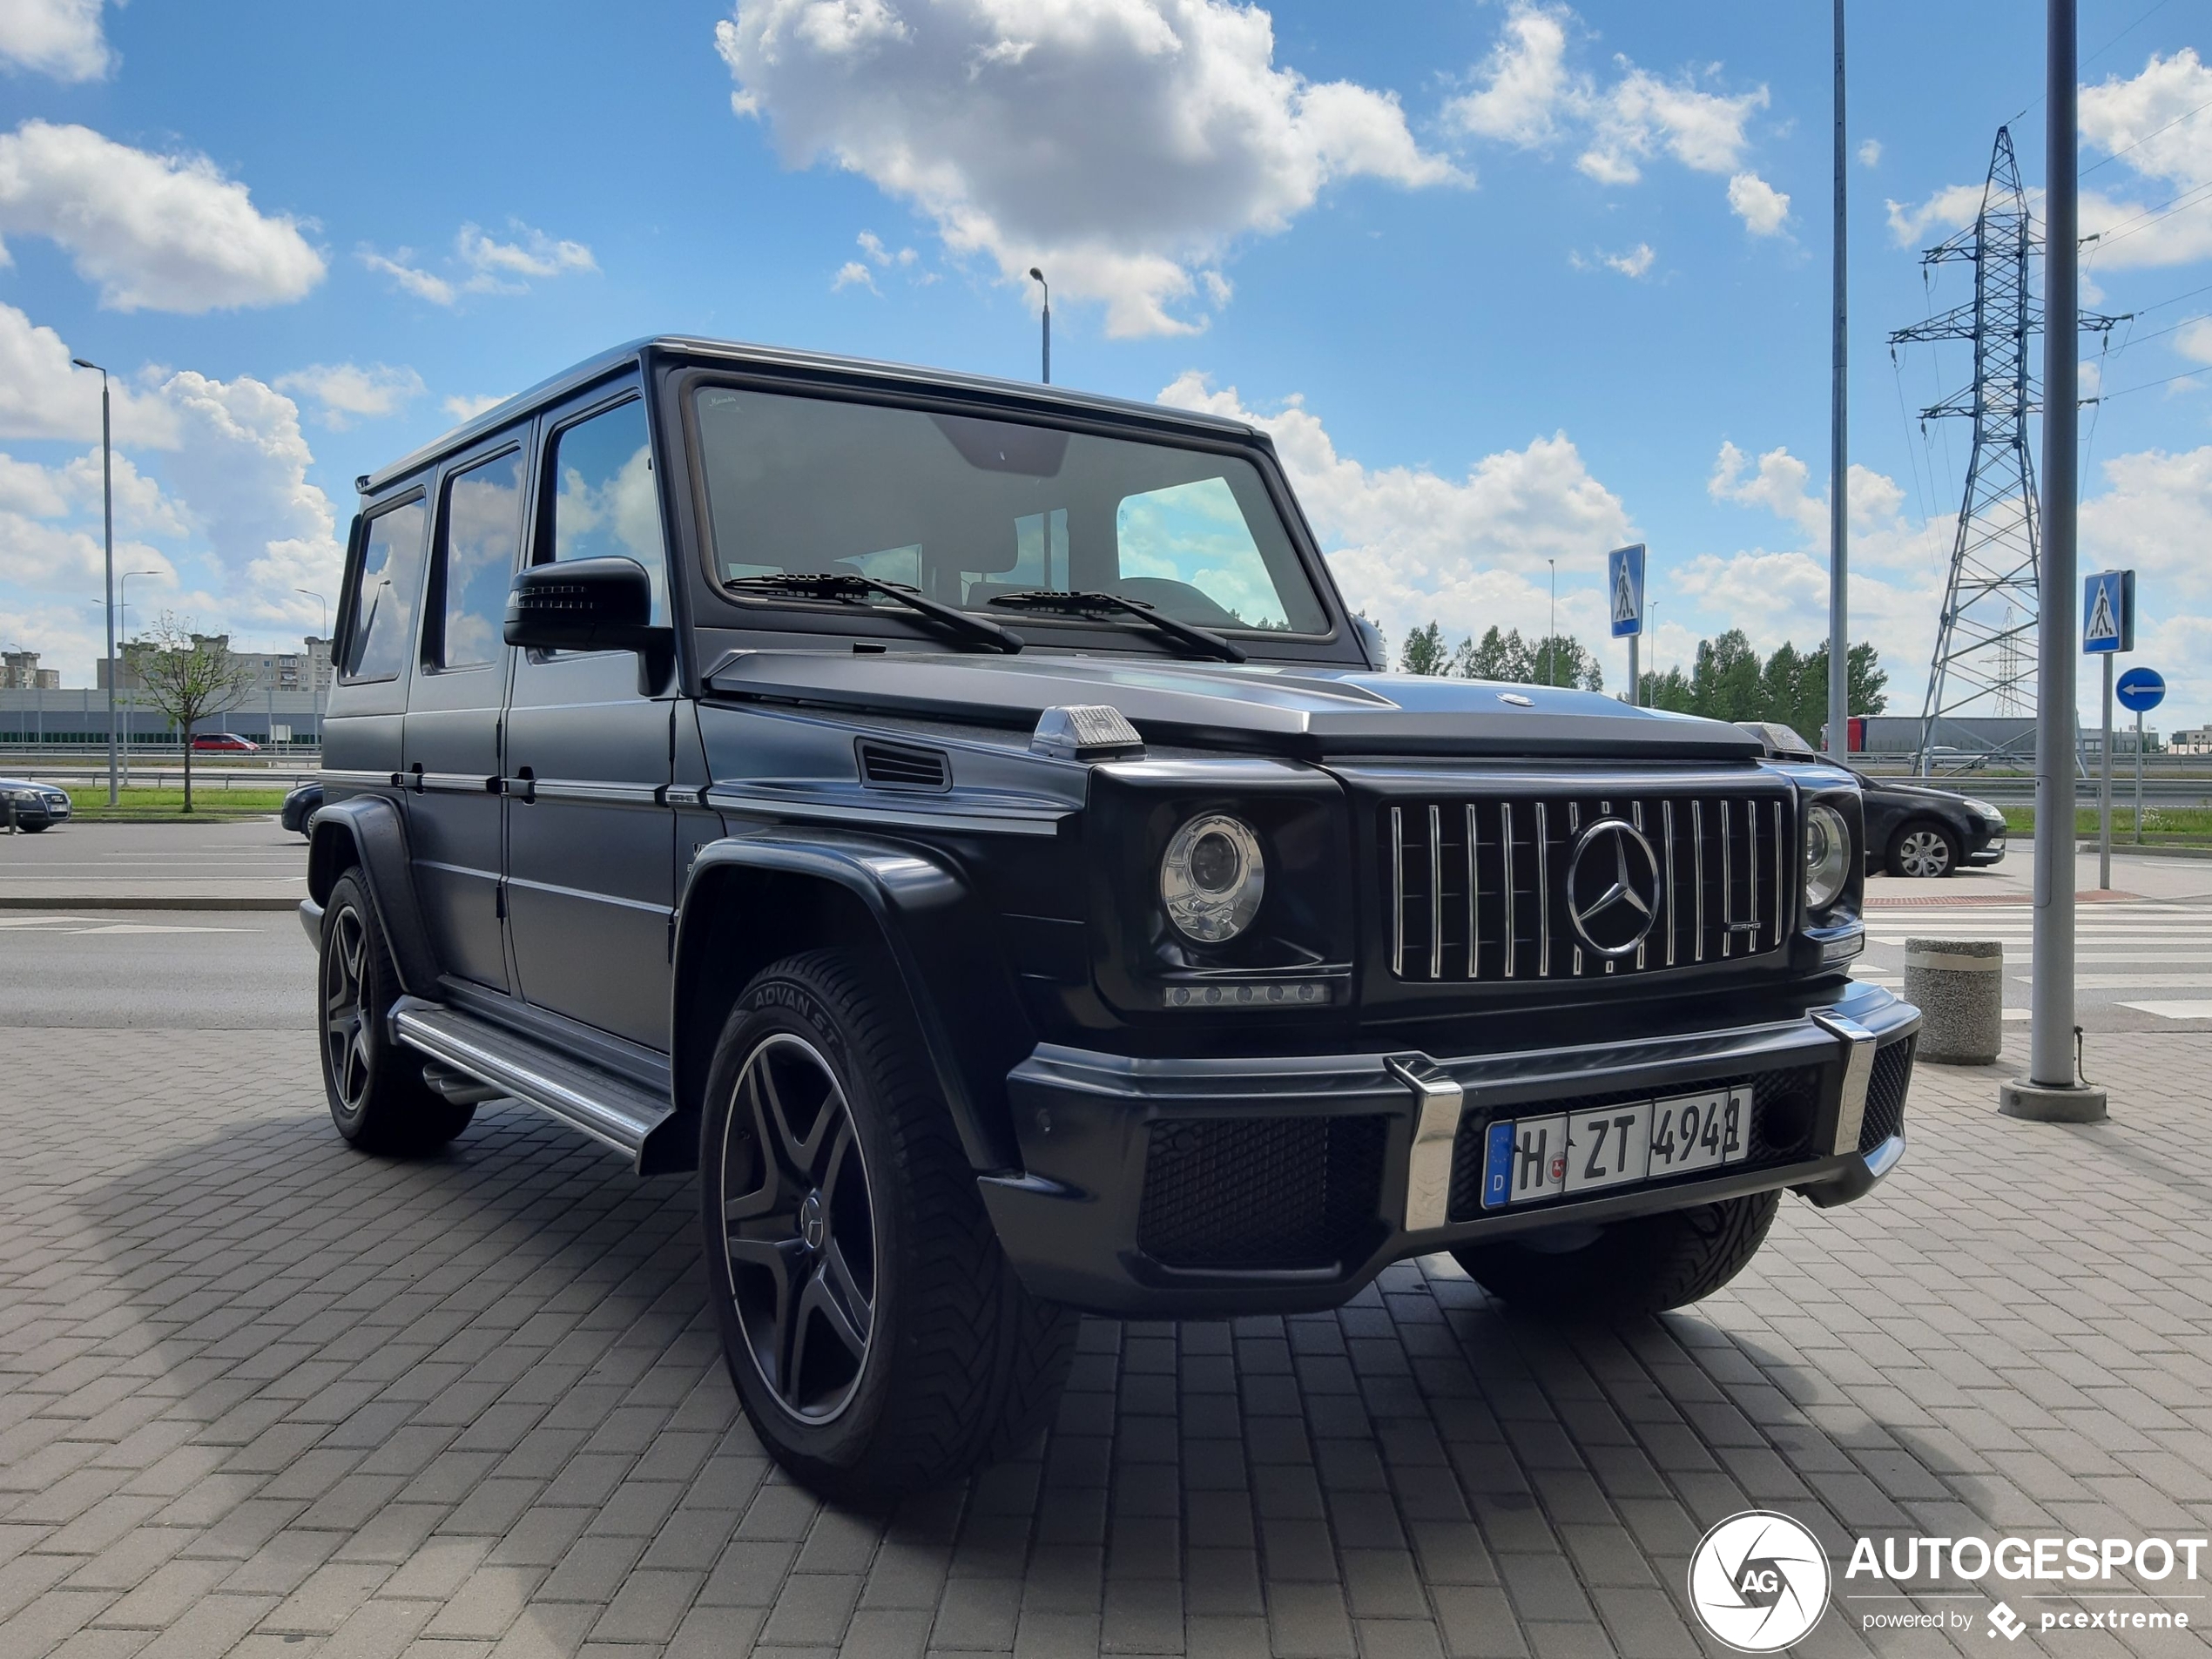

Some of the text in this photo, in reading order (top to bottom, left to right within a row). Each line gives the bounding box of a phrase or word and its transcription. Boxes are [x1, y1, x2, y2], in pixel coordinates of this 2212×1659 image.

[756, 987, 809, 1017] ADVAN
[1520, 1097, 1740, 1190] H ZT 4941
[1494, 1175, 1503, 1190] D
